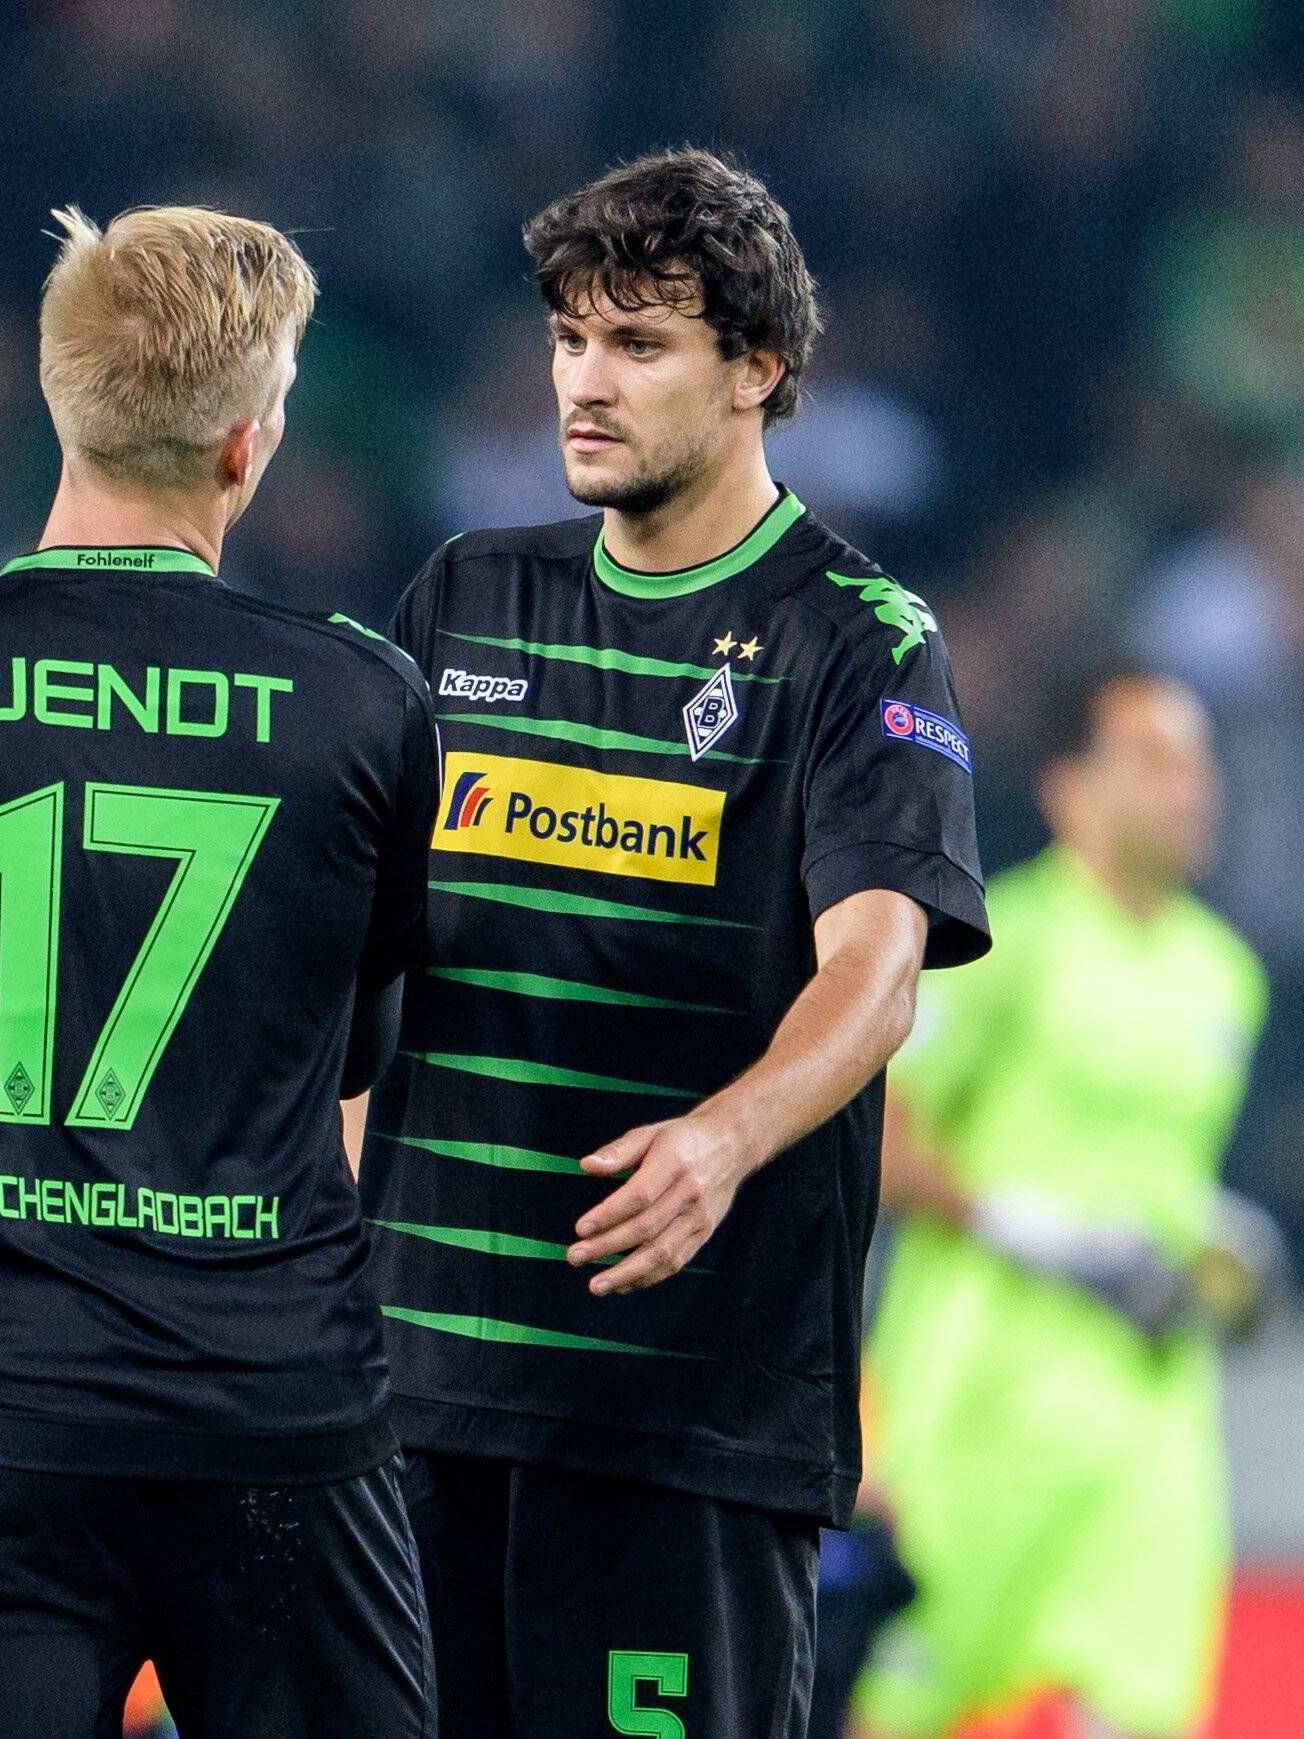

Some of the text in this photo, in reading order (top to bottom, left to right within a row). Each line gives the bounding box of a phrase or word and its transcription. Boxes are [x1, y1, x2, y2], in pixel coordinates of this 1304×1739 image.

[77, 551, 155, 568] Fohlenelf
[439, 668, 528, 702] Kappa
[915, 717, 969, 762] RESPECT
[505, 791, 708, 861] Postbank
[608, 1650, 688, 1739] 5
